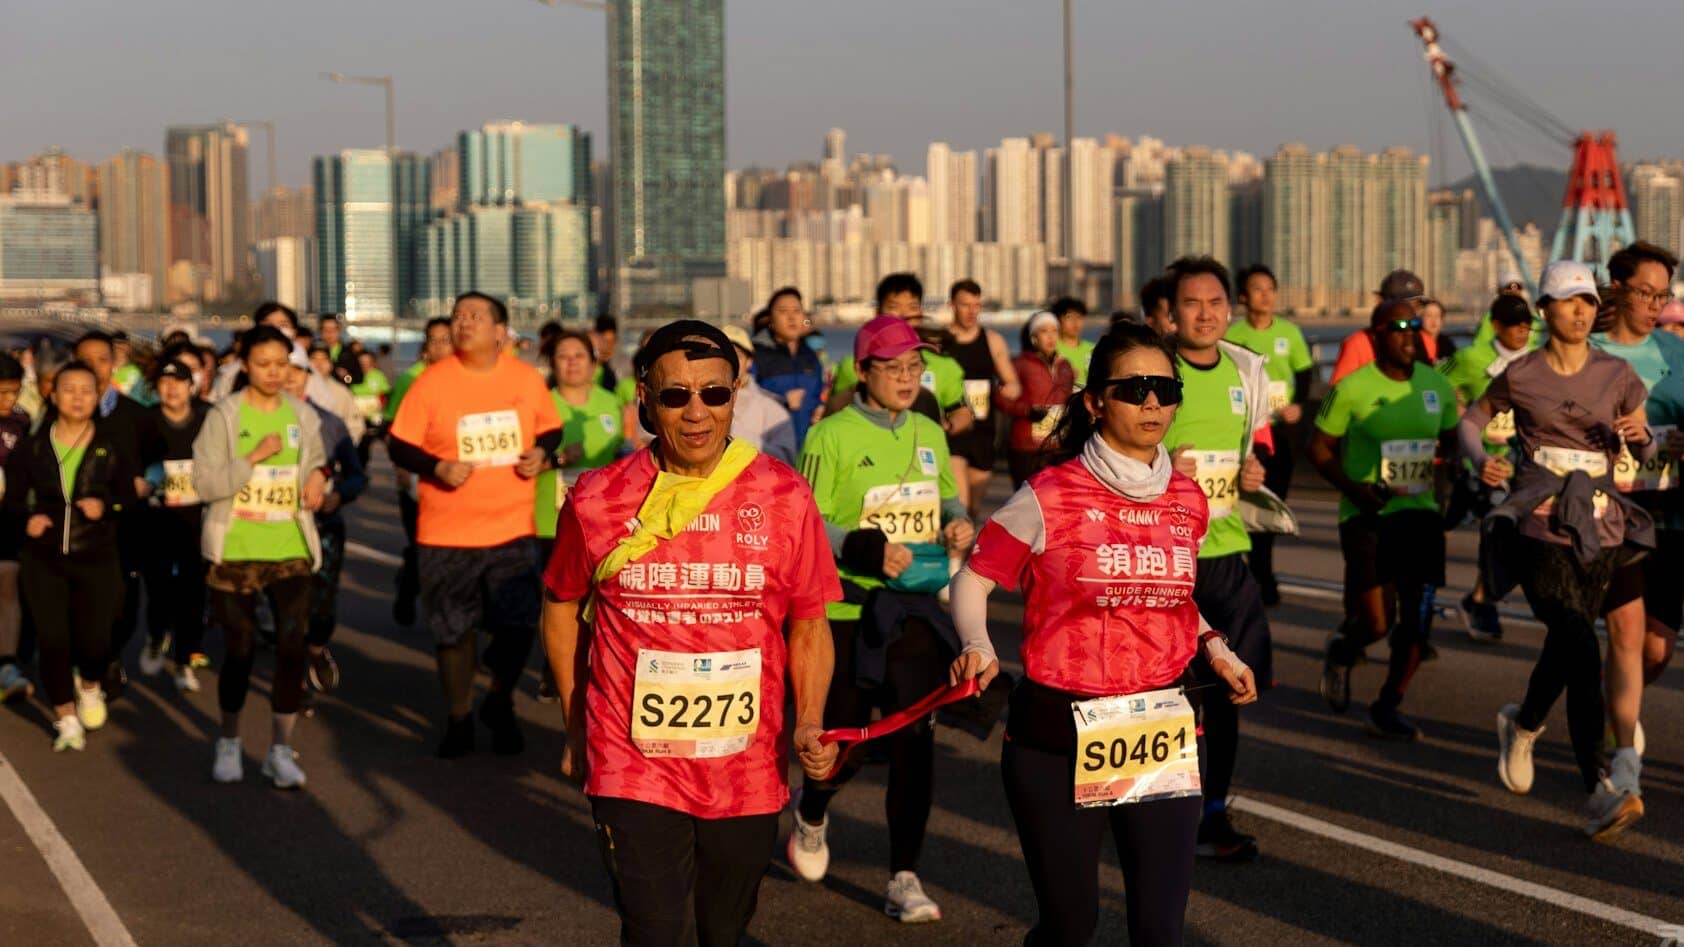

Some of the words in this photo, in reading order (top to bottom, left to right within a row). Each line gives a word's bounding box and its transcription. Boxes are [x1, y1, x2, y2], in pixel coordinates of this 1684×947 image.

[461, 431, 518, 454] S1361
[239, 484, 294, 505] S1423
[1196, 477, 1237, 500] 324
[682, 514, 720, 532] MON
[866, 508, 934, 535] S3781
[1118, 508, 1161, 526] FANNY
[736, 533, 769, 546] ROLY
[1169, 525, 1193, 537] ROLY
[1096, 543, 1193, 578] 領跑員
[619, 562, 766, 591] 視障運動員
[1104, 586, 1142, 595] GUIDE
[1144, 588, 1188, 598] RUNNER
[625, 600, 671, 609] VISUALLY
[639, 690, 755, 728] S2273
[1082, 726, 1187, 772] S0461
